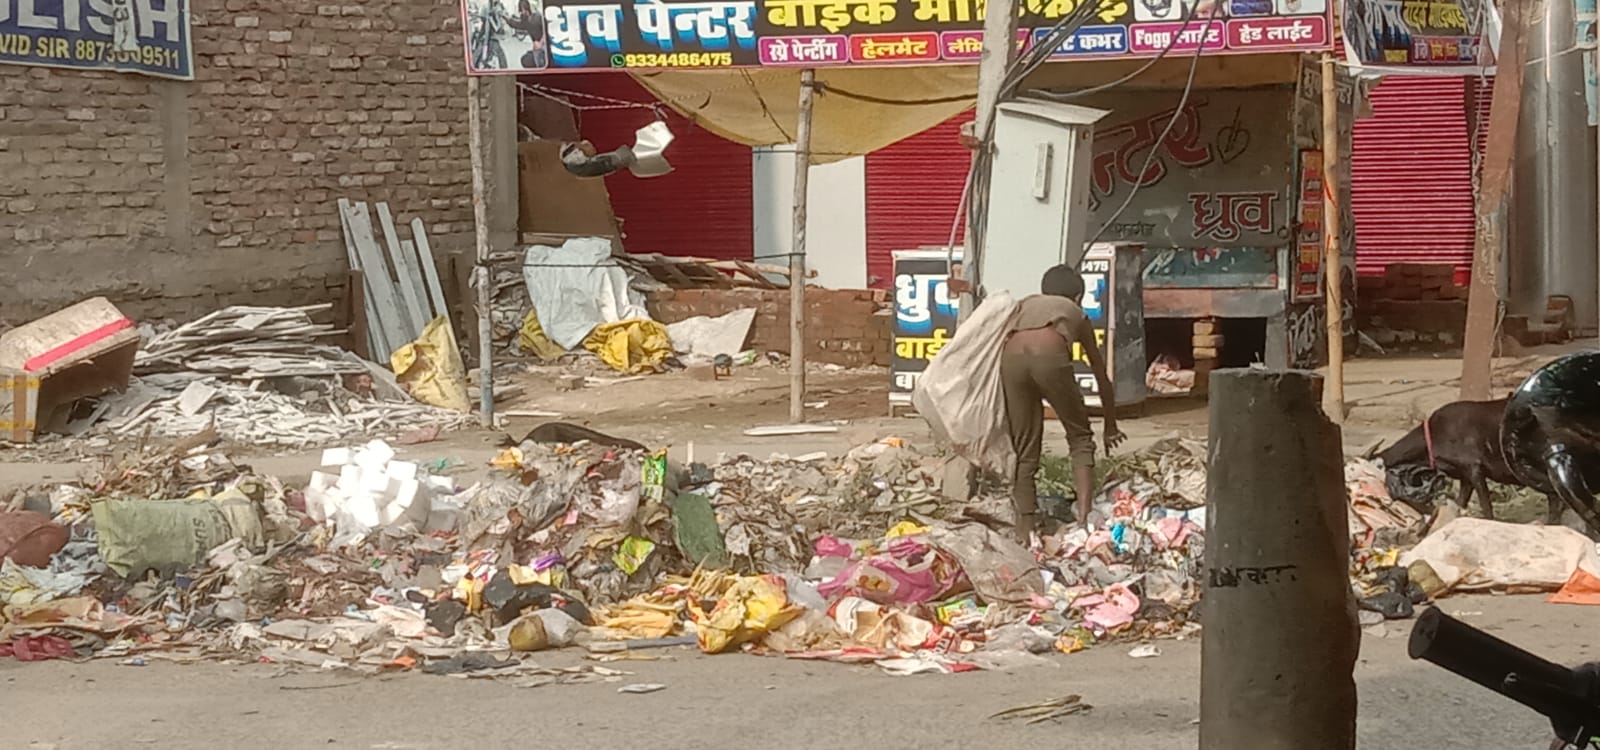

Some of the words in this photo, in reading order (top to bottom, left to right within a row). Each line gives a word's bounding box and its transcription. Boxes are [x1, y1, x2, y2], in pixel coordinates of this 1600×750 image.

[0, 0, 181, 42] LISH
[1266, 20, 1313, 42] लाईट
[36, 36, 70, 59] SIR
[1135, 29, 1171, 48] Fogg
[625, 53, 732, 67] 9334486475
[1188, 191, 1278, 242] ध्रुव
[1081, 261, 1108, 272] 475
